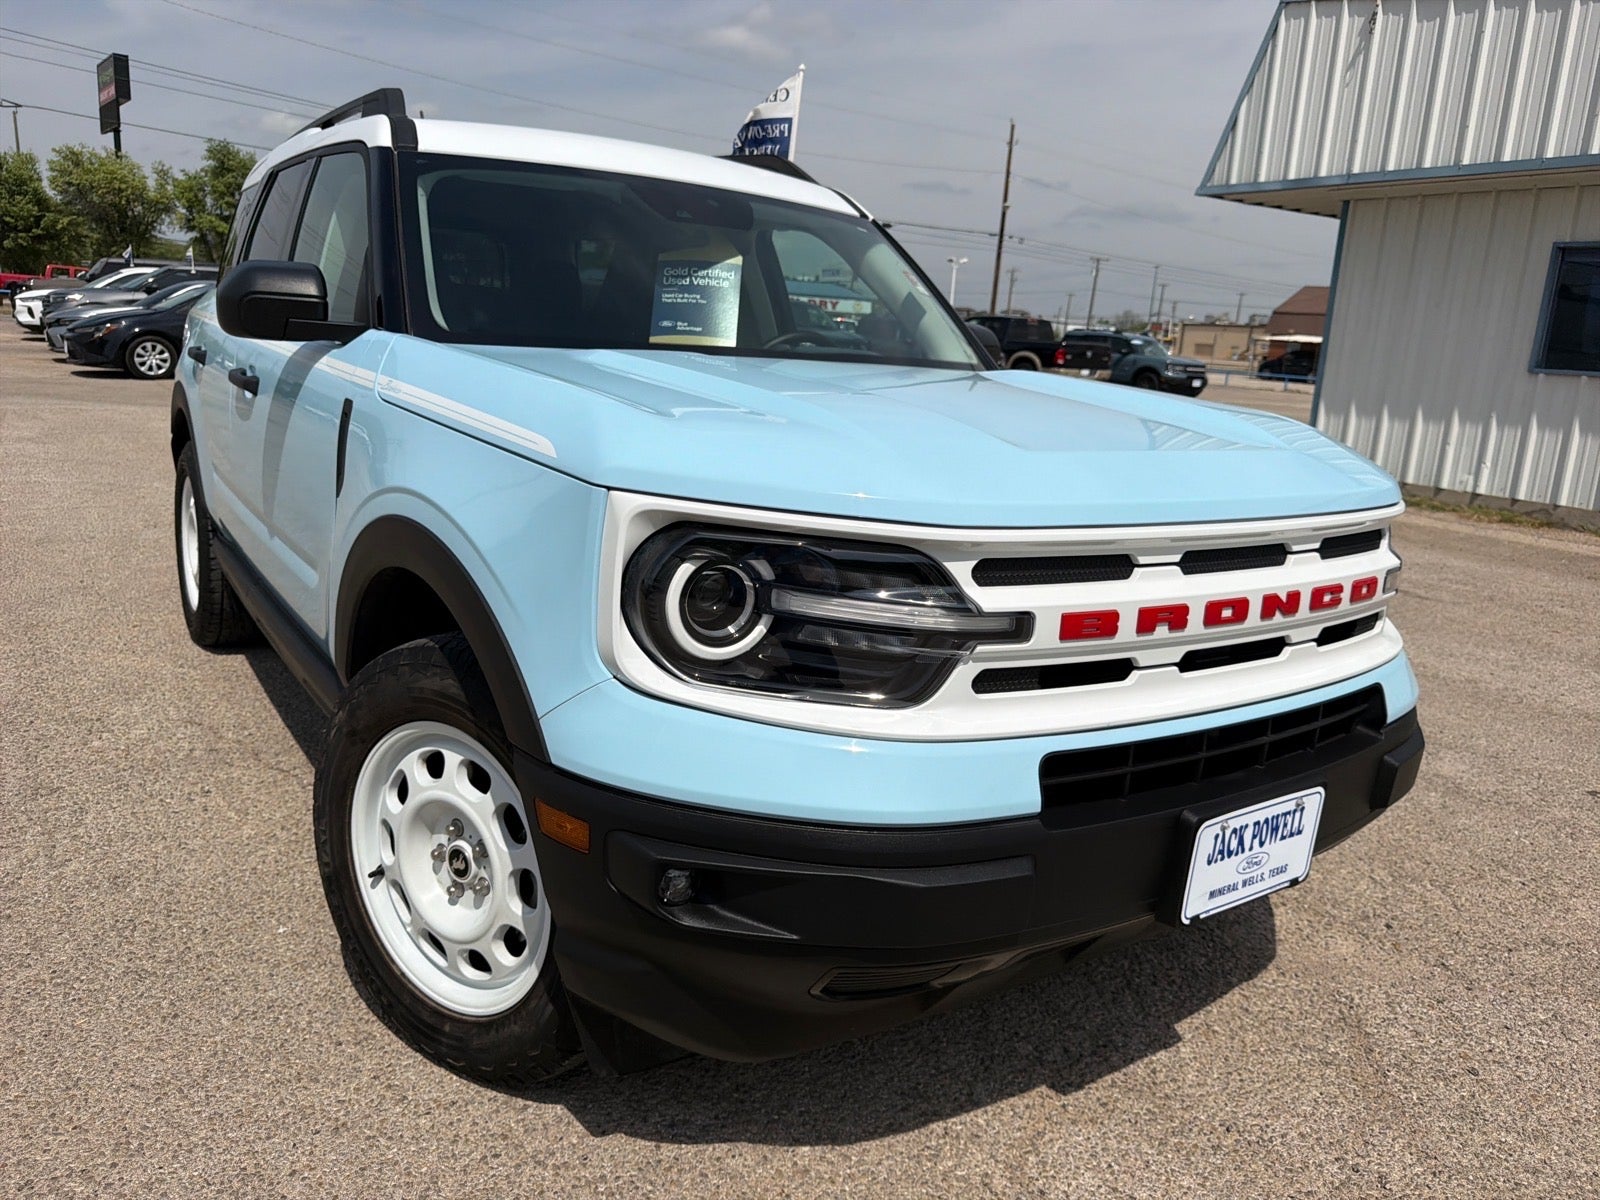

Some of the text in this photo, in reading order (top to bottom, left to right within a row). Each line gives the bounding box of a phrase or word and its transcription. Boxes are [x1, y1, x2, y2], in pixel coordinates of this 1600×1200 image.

[663, 268, 735, 279] Gold Certified
[663, 277, 729, 287] Used Vehicle
[1059, 576, 1378, 642] BRONCO
[1207, 806, 1306, 866] JACK POWELL
[1242, 855, 1264, 871] Ford
[1208, 884, 1239, 900] MINERAL
[1268, 863, 1289, 881] TEXAS
